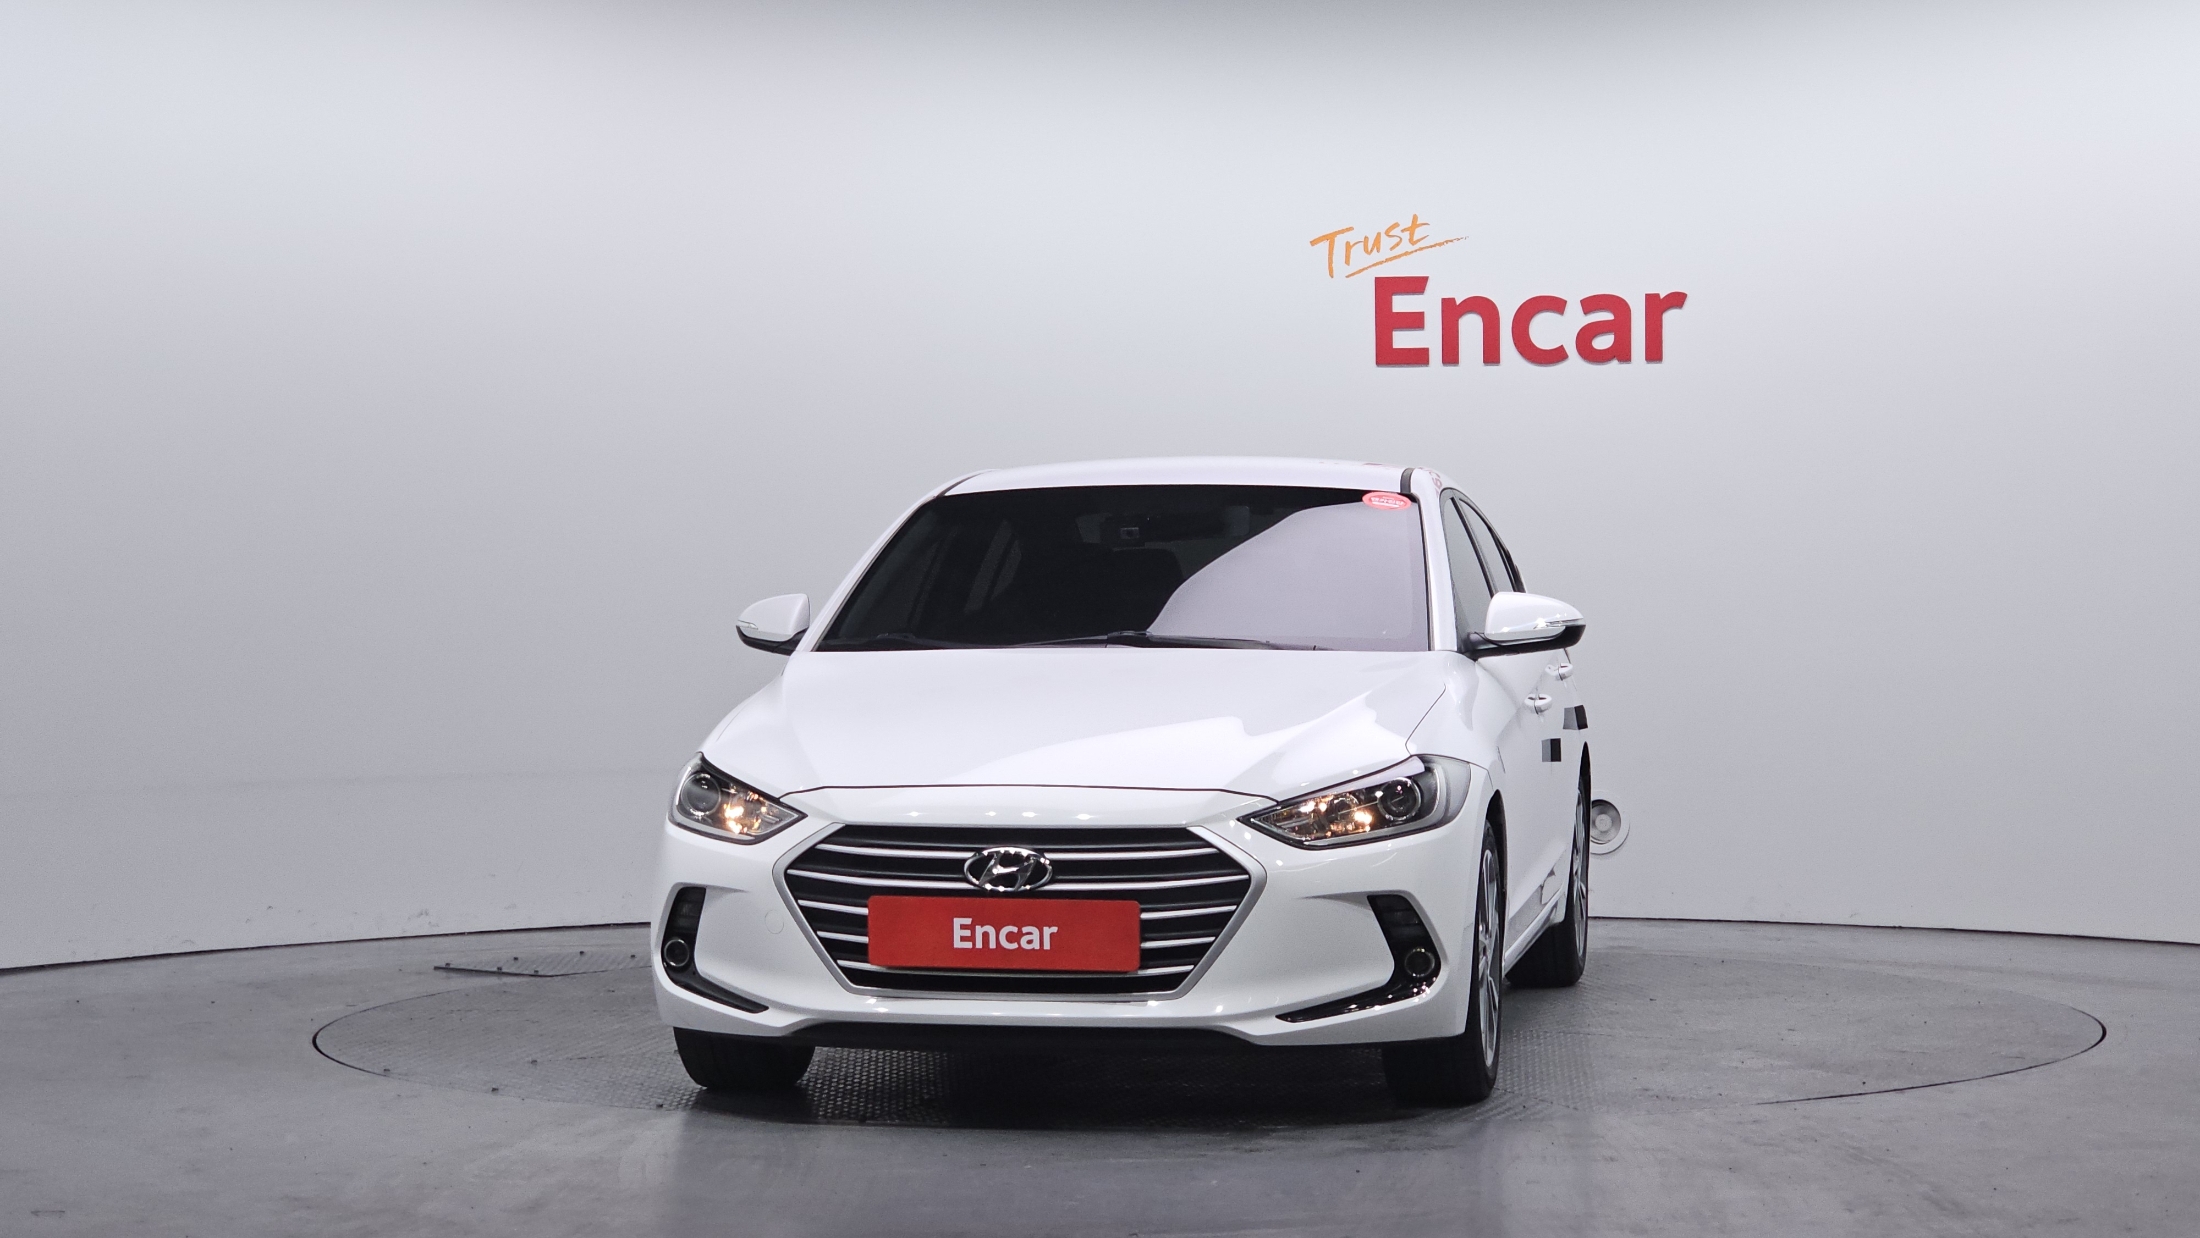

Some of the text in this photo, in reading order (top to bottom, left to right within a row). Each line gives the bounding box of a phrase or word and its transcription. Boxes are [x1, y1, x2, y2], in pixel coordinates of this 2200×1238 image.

[1310, 213, 1431, 278] Trust
[1374, 275, 1688, 367] Encar
[952, 916, 1059, 951] Encar
